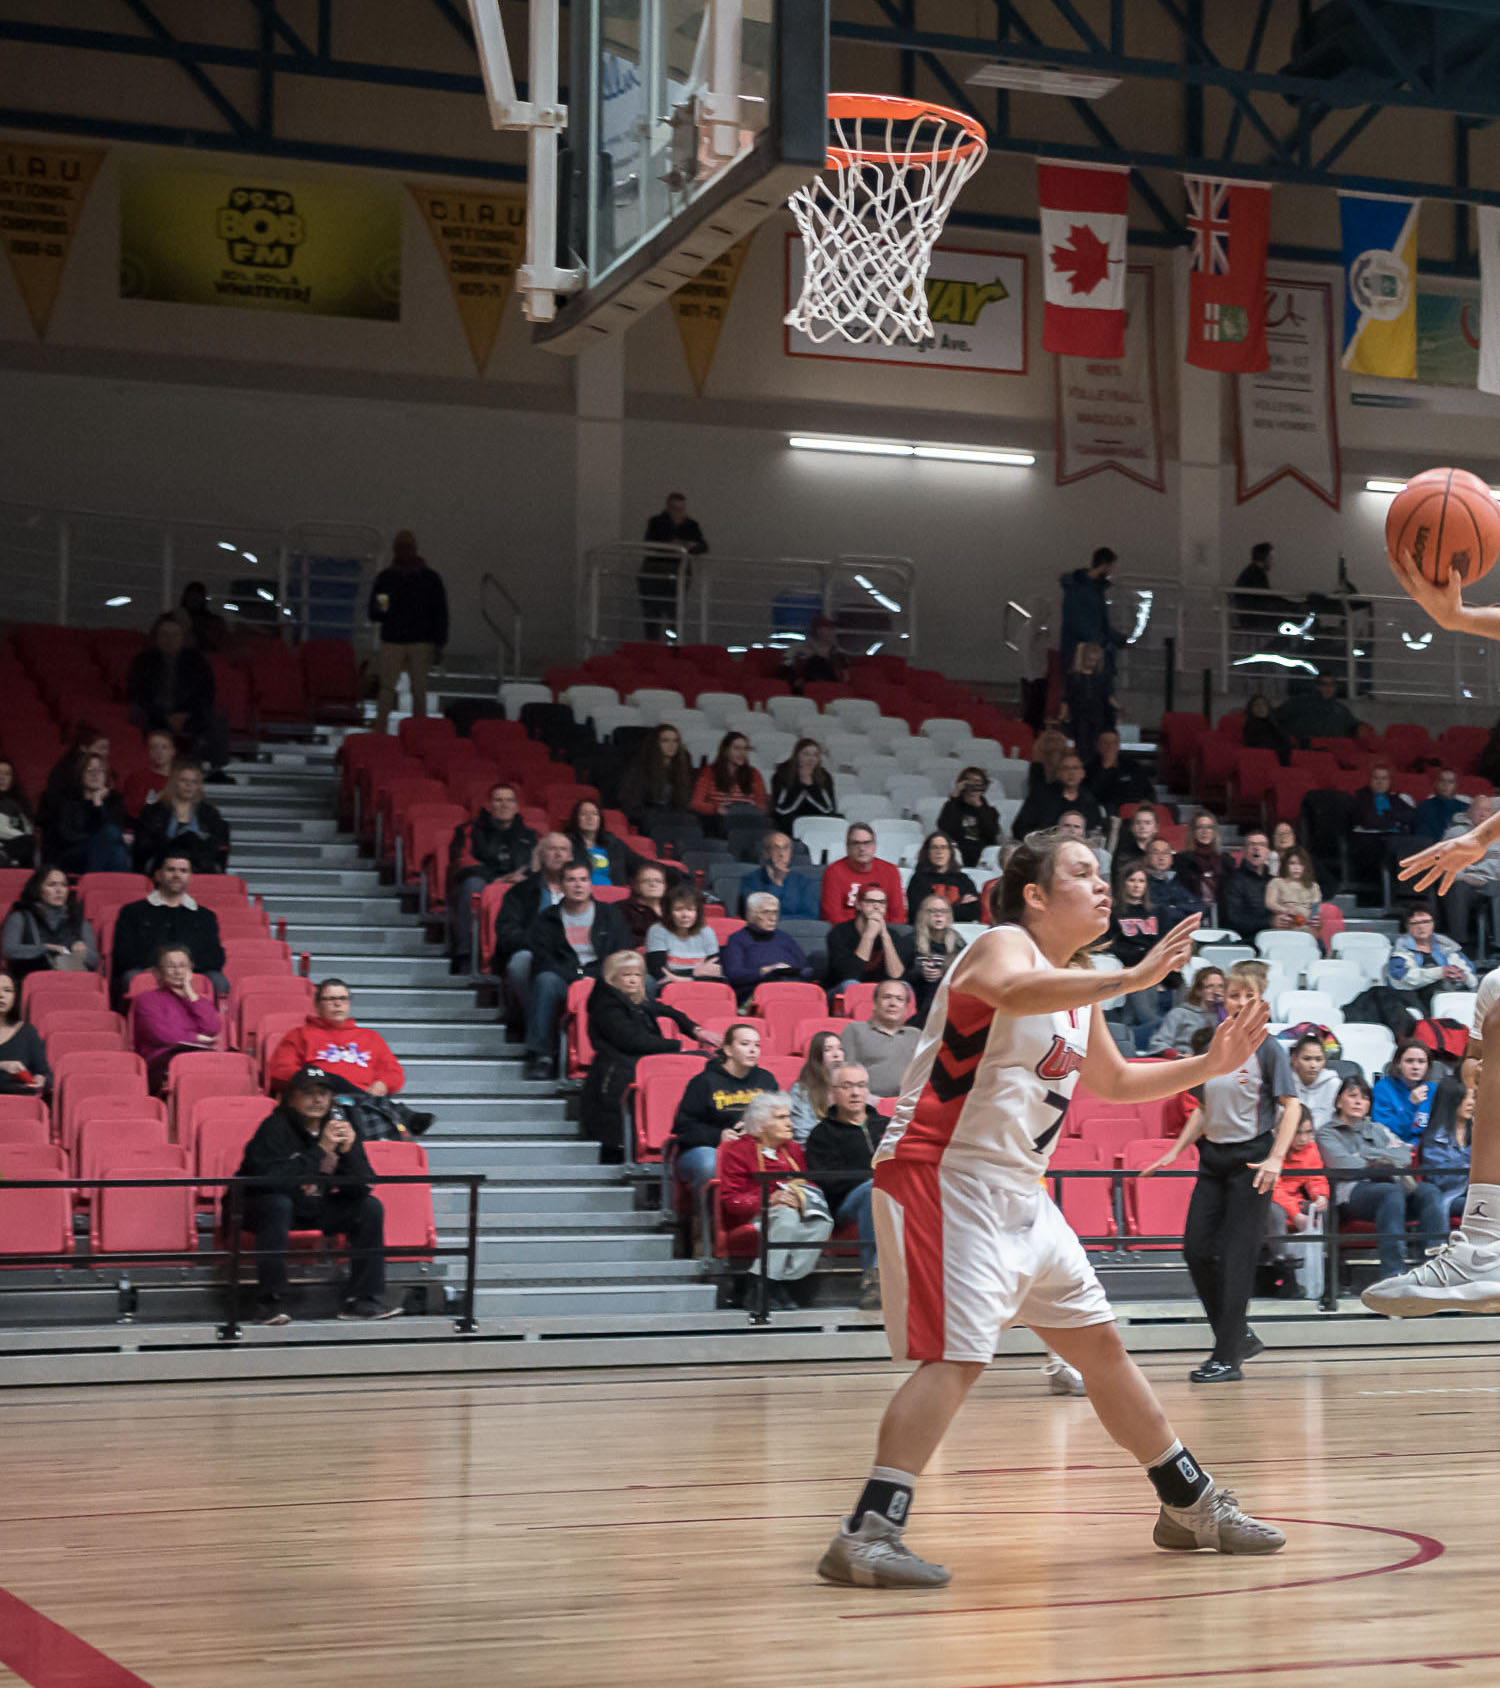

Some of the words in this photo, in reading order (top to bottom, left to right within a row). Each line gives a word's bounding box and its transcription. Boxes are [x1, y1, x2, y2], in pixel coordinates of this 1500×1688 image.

[216, 208, 305, 246] BOB
[441, 226, 519, 246] NATIONAL
[232, 243, 289, 265] FM
[941, 334, 973, 352] Ave.
[1031, 1089, 1070, 1154] 7
